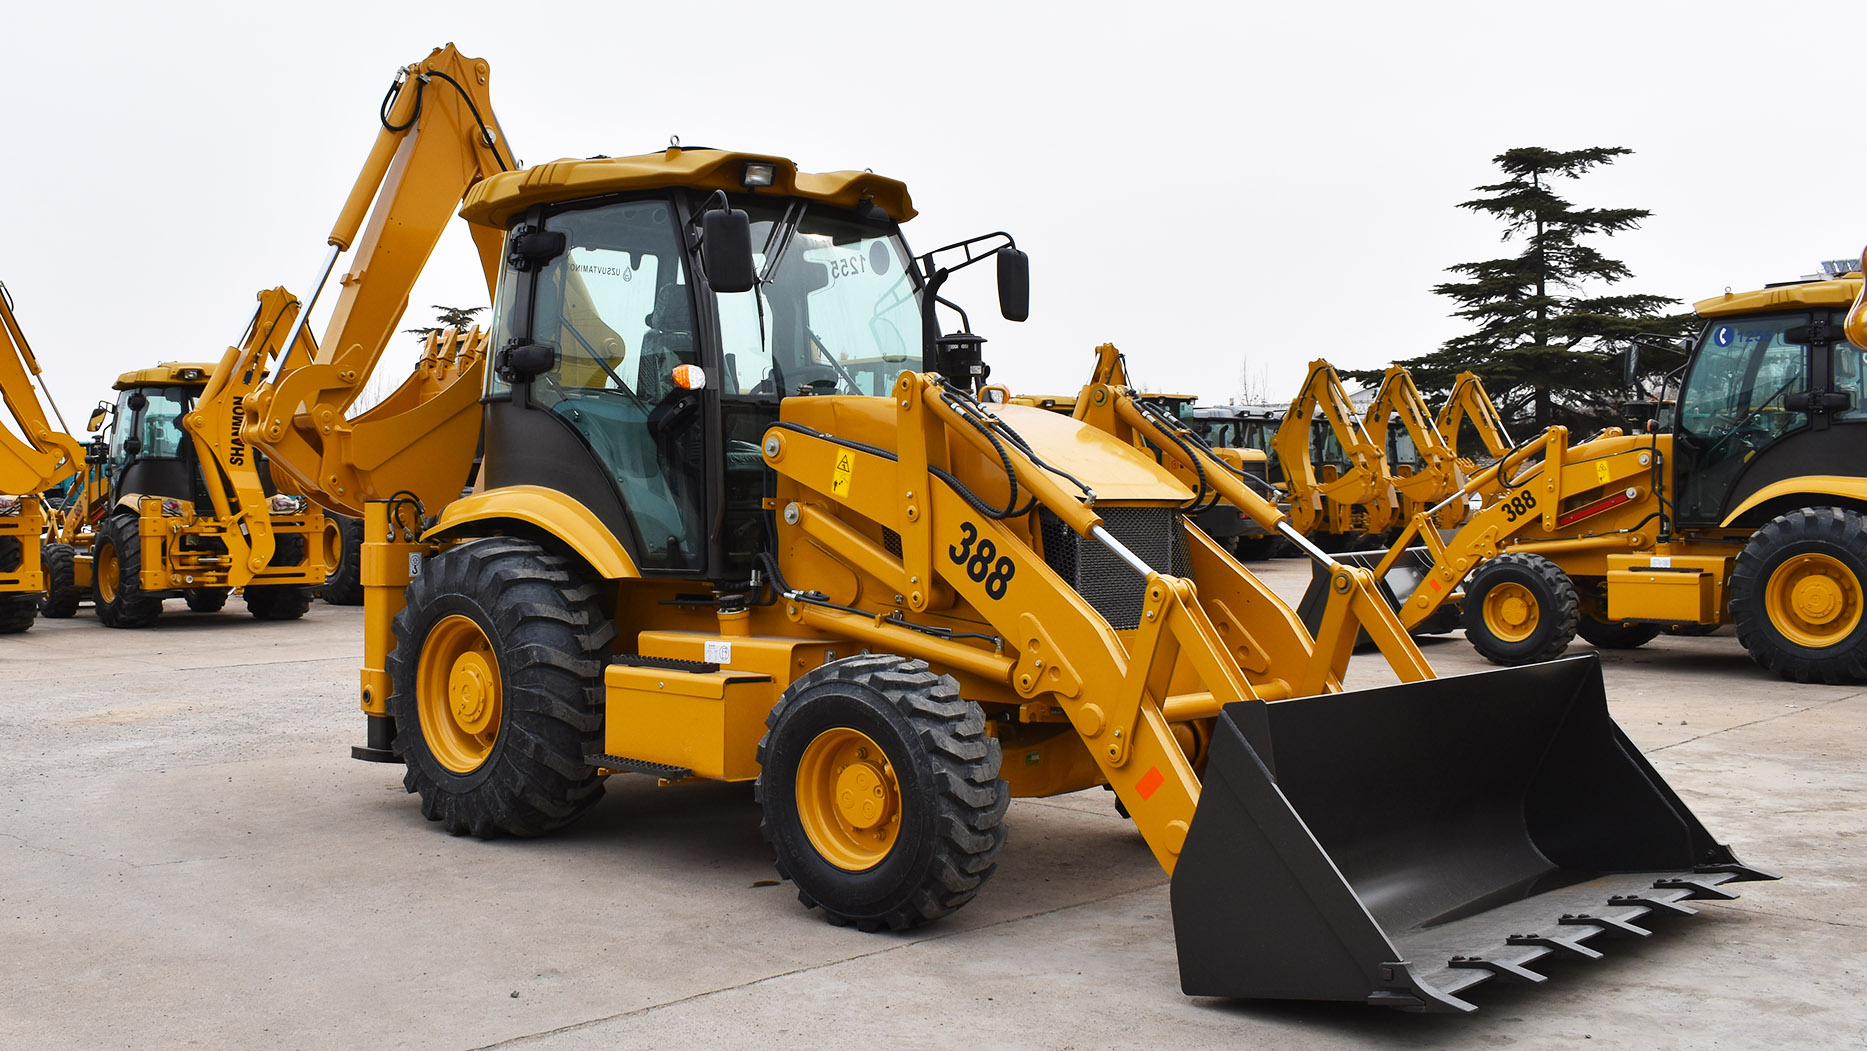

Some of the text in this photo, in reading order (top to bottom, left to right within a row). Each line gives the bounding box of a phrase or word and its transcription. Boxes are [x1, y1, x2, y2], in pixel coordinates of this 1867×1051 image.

[230, 396, 245, 466] SHANMON
[1501, 490, 1537, 522] 388
[949, 521, 1015, 600] 388
